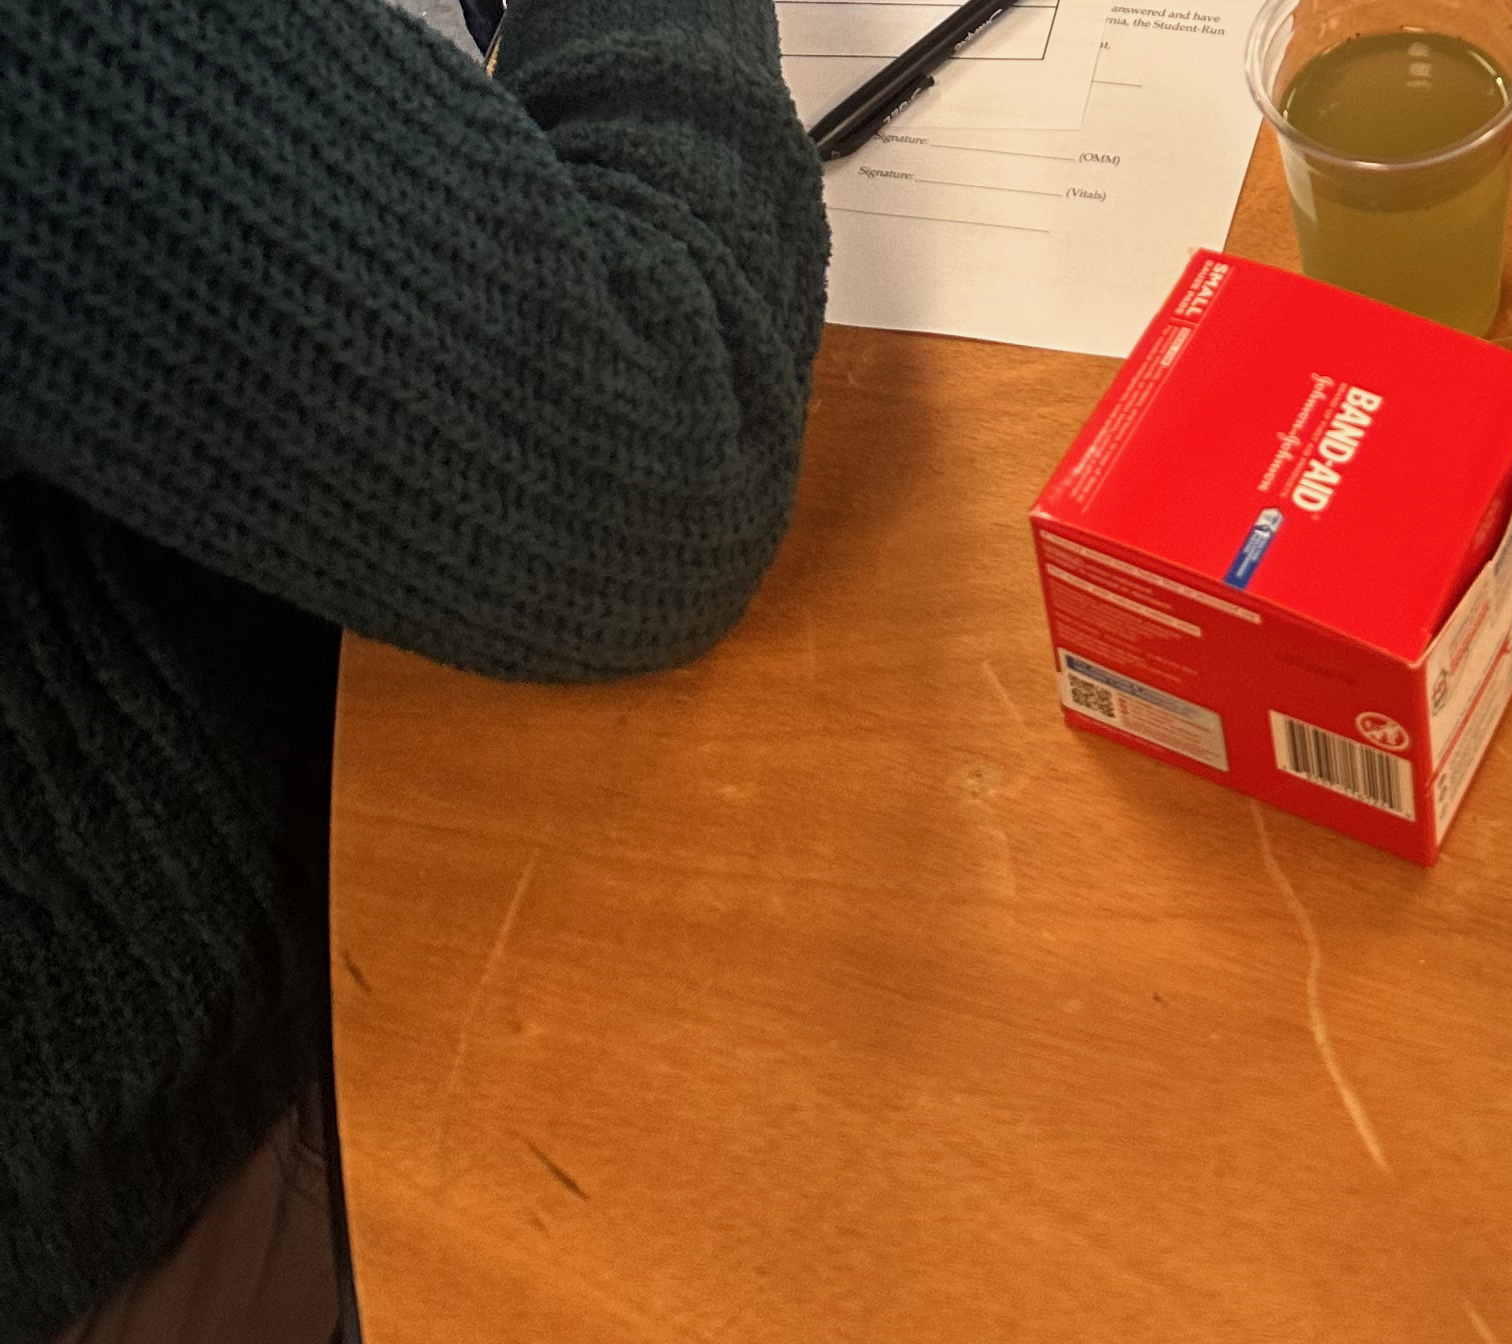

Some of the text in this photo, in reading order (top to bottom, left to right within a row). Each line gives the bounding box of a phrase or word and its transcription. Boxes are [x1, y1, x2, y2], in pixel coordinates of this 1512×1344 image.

[1110, 5, 1221, 22] answered and have
[1152, 20, 1225, 35] Student-Run
[1079, 152, 1120, 166] (OMM)
[1066, 188, 1106, 202] (Vitals)
[1185, 263, 1228, 315] SMALL
[1293, 388, 1380, 510] BAND-AID
